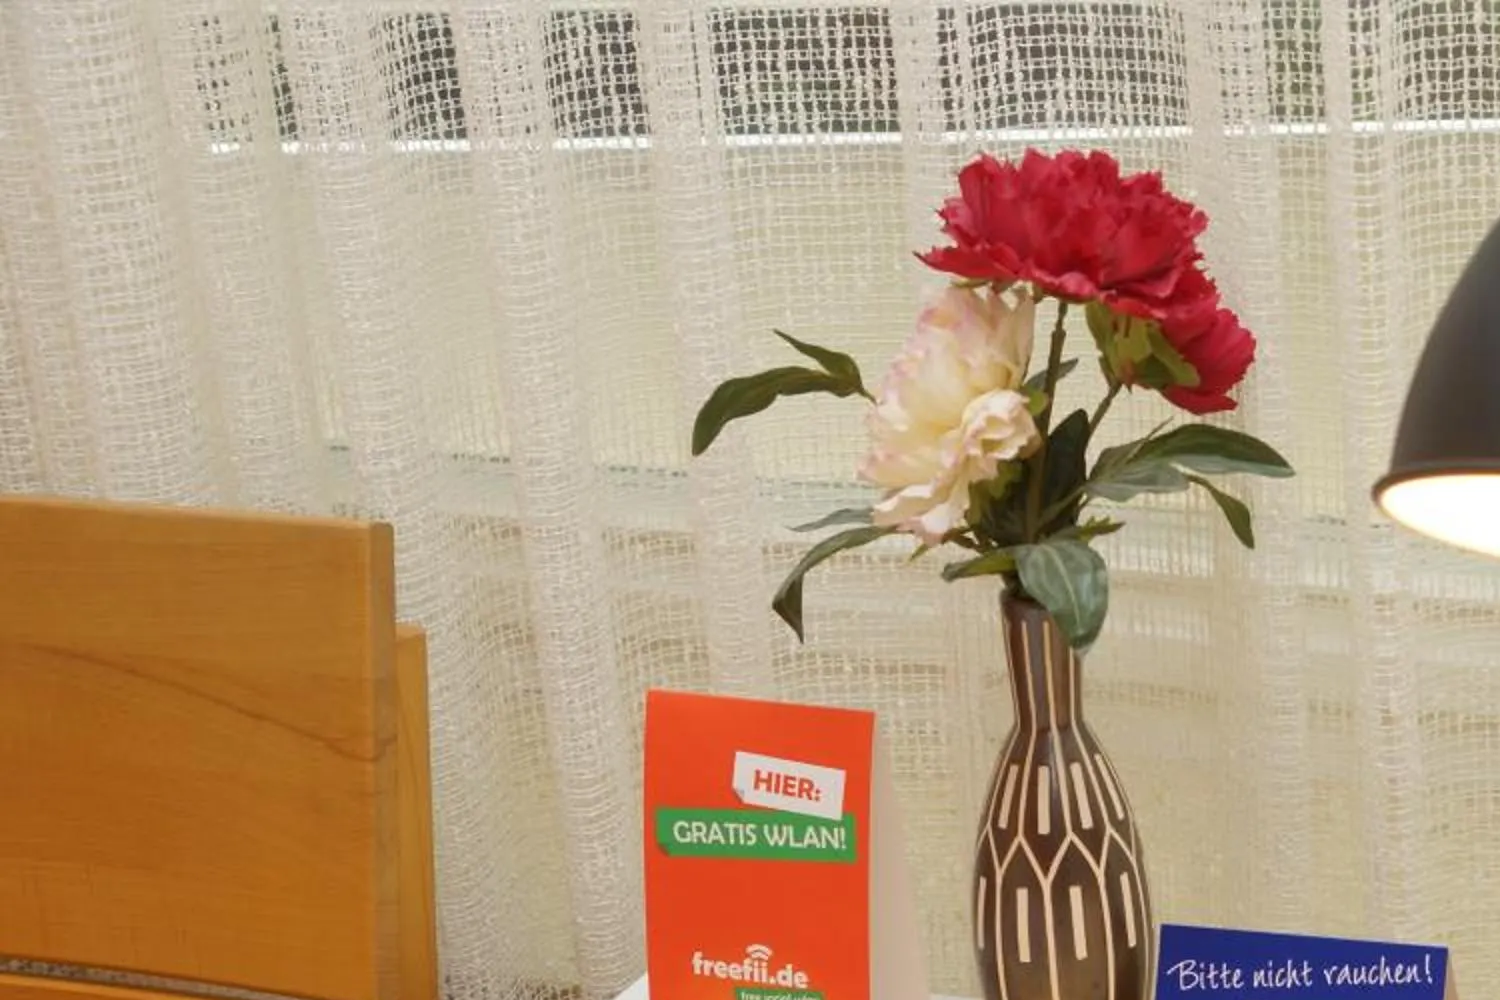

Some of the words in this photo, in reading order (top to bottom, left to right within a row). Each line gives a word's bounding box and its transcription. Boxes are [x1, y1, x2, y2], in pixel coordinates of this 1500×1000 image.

[753, 769, 821, 801] HIER:
[672, 820, 757, 847] GRATIS
[763, 823, 847, 850] WLAN!
[691, 950, 809, 989] freefii.de
[1167, 959, 1244, 990] Bitte
[1252, 955, 1313, 988] nicht
[1324, 954, 1433, 986] rauchen!
